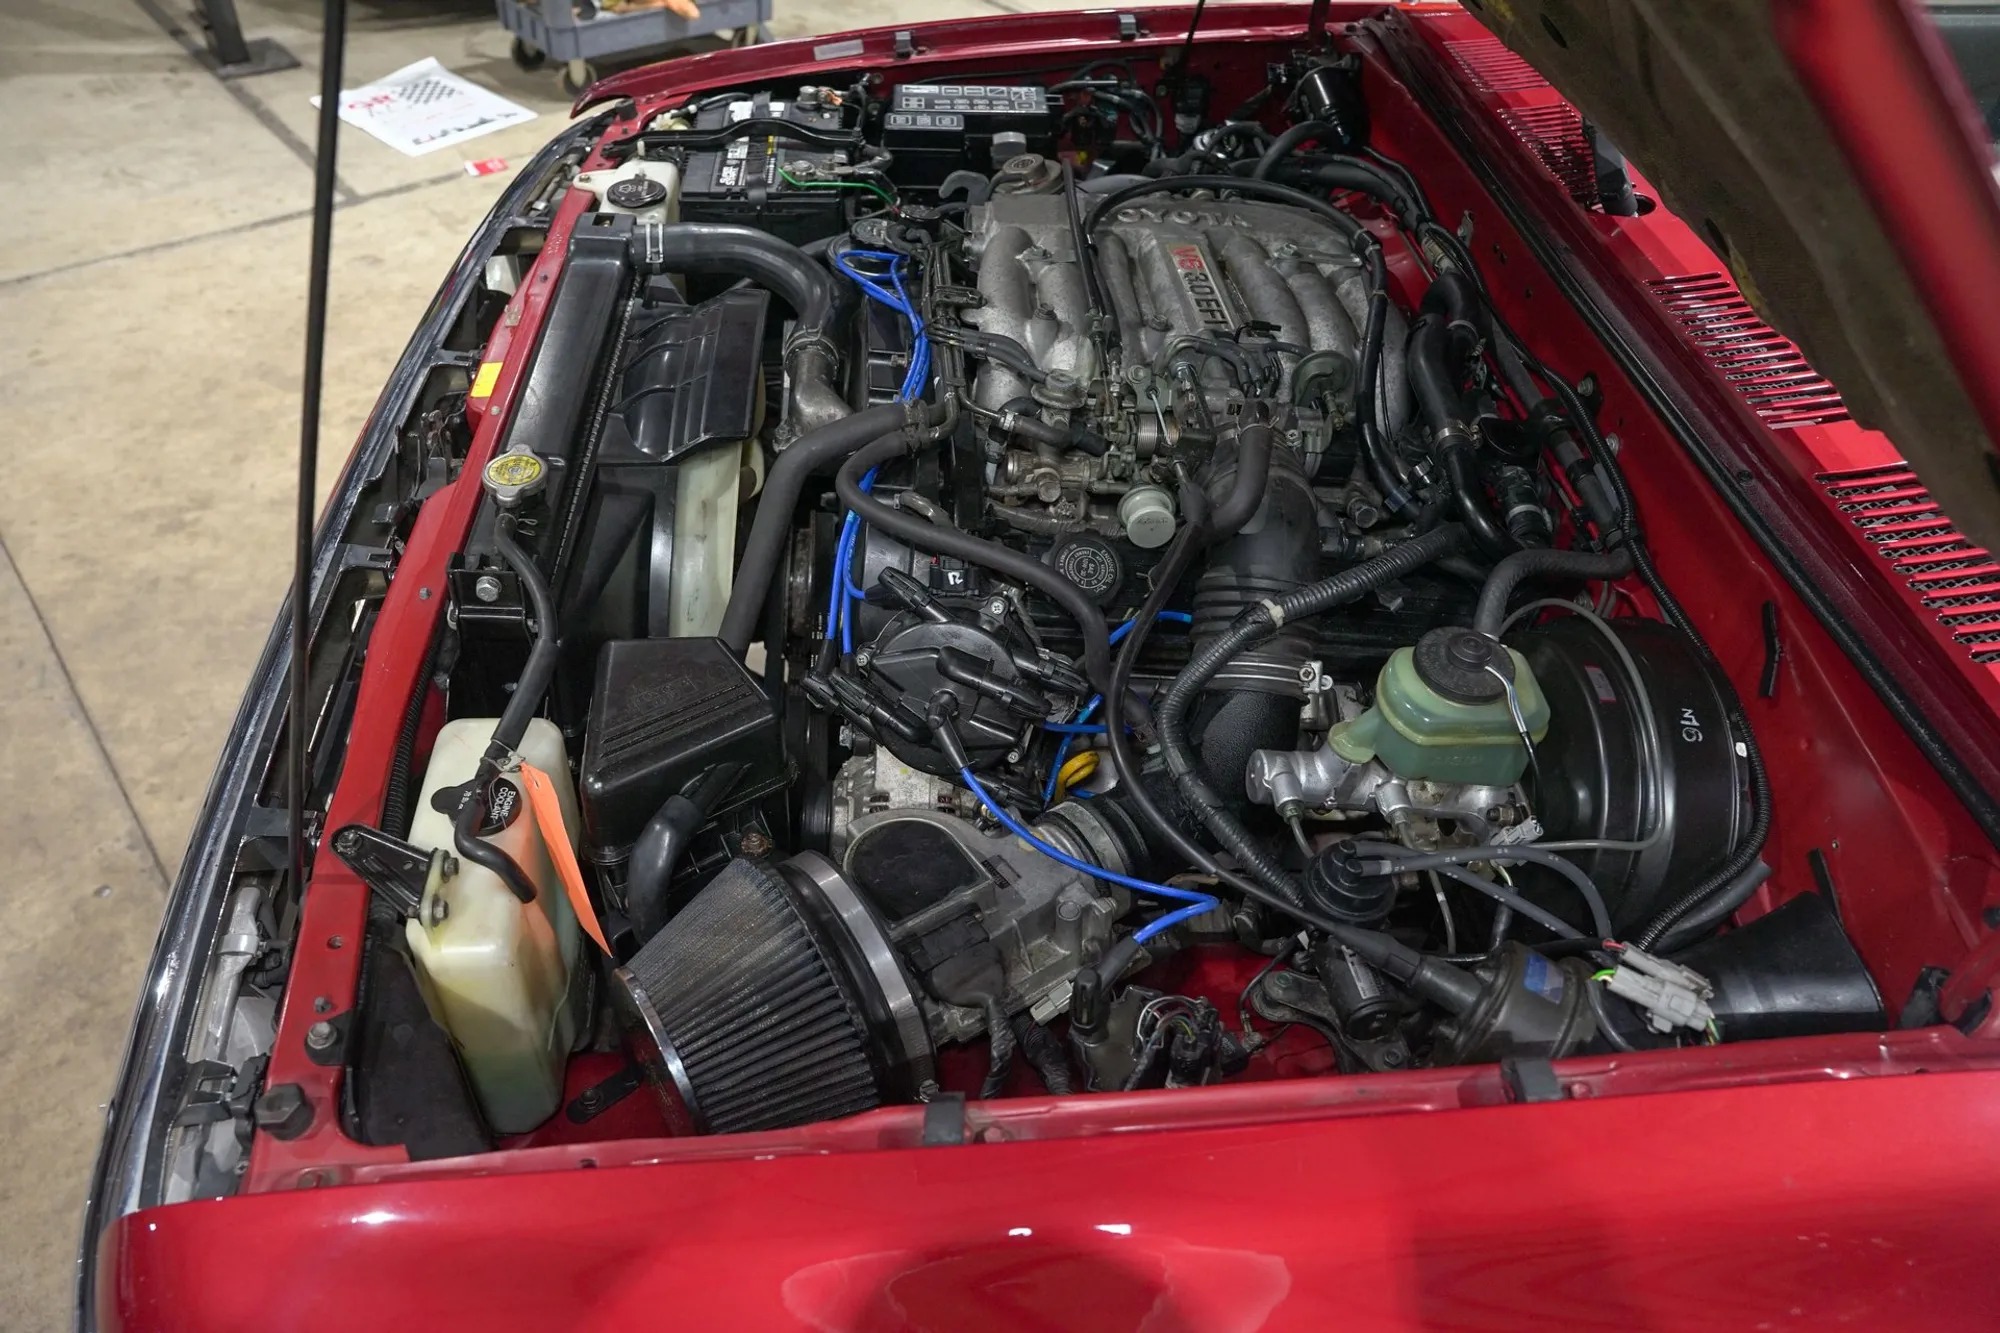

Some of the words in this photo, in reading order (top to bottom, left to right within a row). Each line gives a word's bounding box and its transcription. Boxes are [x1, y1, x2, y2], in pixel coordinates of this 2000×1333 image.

[1101, 208, 1252, 228] OYOTA
[1170, 246, 1206, 271] V6
[1101, 549, 1115, 573] ENGINE
[490, 787, 508, 819] COOLANT
[501, 791, 516, 817] ENGINE
